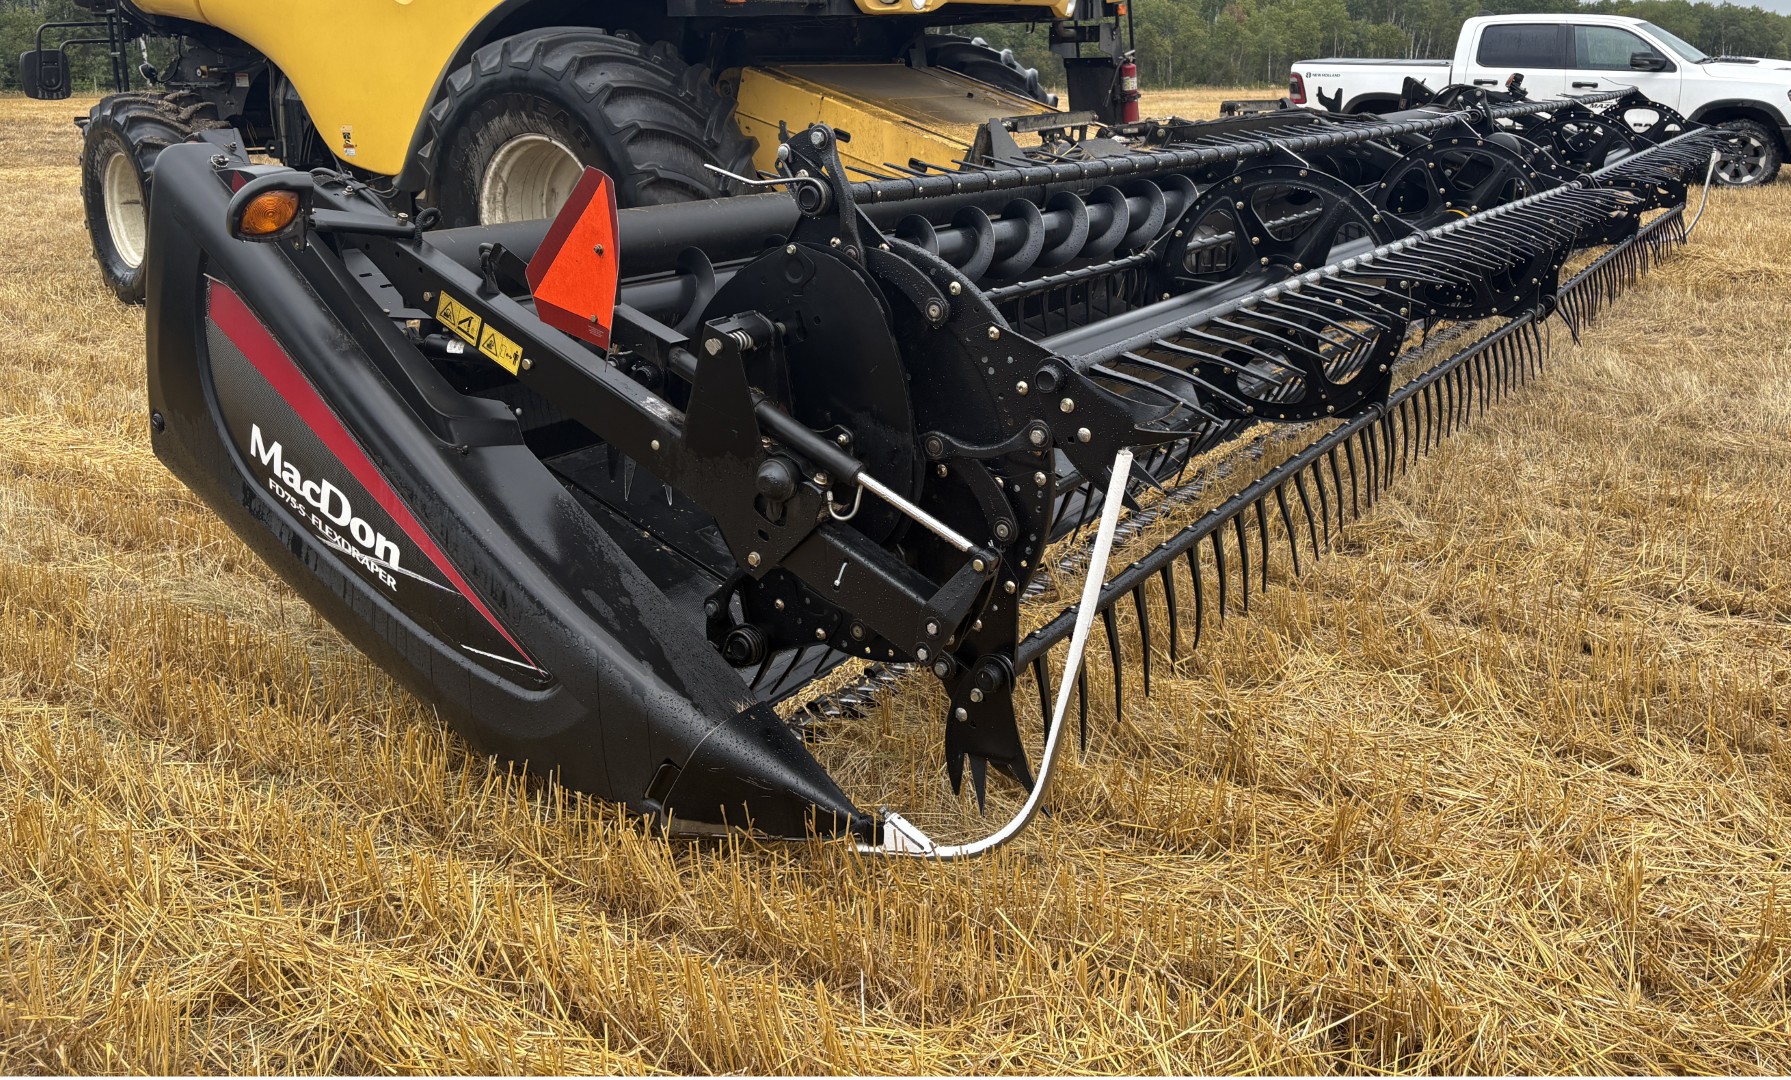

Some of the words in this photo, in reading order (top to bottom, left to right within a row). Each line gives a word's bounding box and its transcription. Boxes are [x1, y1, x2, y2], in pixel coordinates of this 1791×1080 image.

[250, 423, 400, 571] MacDon
[268, 477, 306, 517] FD75-S
[311, 513, 397, 592] FLEXDRAPER
